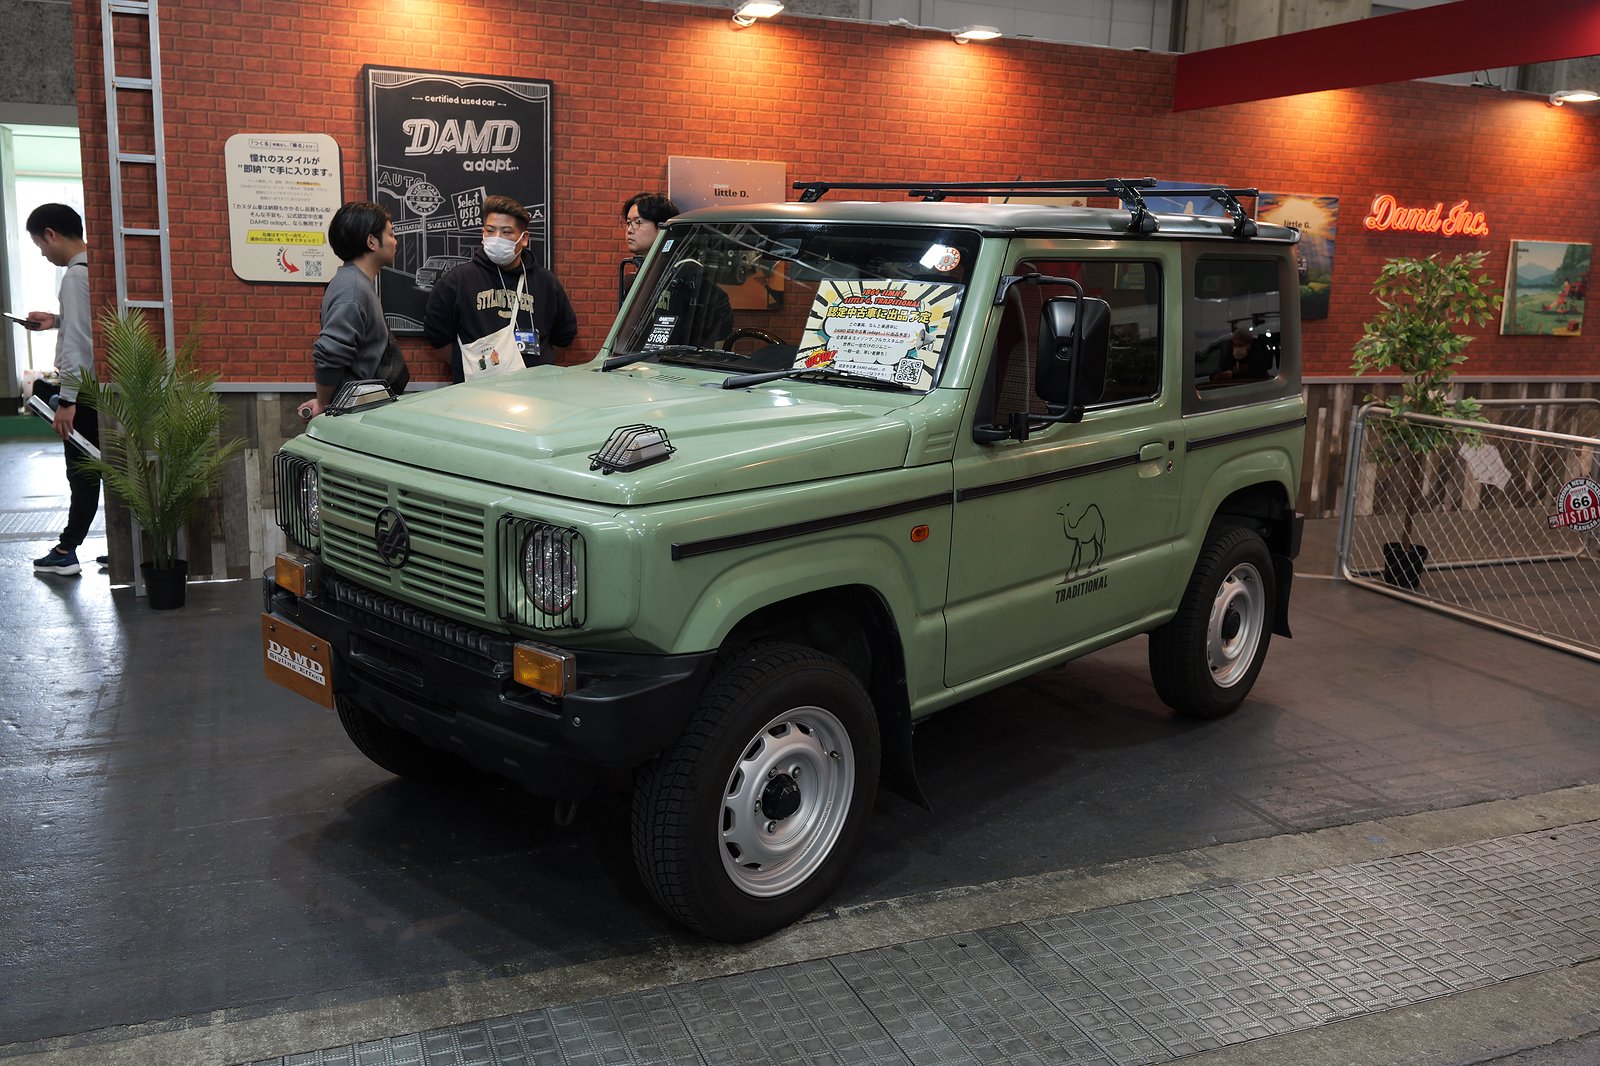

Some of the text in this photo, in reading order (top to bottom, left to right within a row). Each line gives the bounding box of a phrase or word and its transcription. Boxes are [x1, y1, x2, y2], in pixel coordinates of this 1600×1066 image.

[424, 94, 496, 107] certified used car
[402, 118, 521, 156] DAMD
[249, 153, 320, 165] 憧れのスタイルが
[426, 185, 438, 196] CAR
[714, 188, 749, 198] little D.
[457, 191, 480, 208] Select
[459, 205, 481, 220] USED
[1364, 194, 1489, 236] Damd Inc.
[426, 219, 456, 230] SUZUKI
[461, 217, 483, 228] CAR
[873, 297, 921, 308] TRADITIONAL
[826, 305, 932, 324] 認定中古車に出品予定
[1572, 496, 1591, 509] 66
[1558, 507, 1600, 527] HISTOR
[1055, 575, 1108, 604] TRADITIONAL
[268, 639, 324, 674] DAMD
[269, 652, 324, 682] Styling Effect
